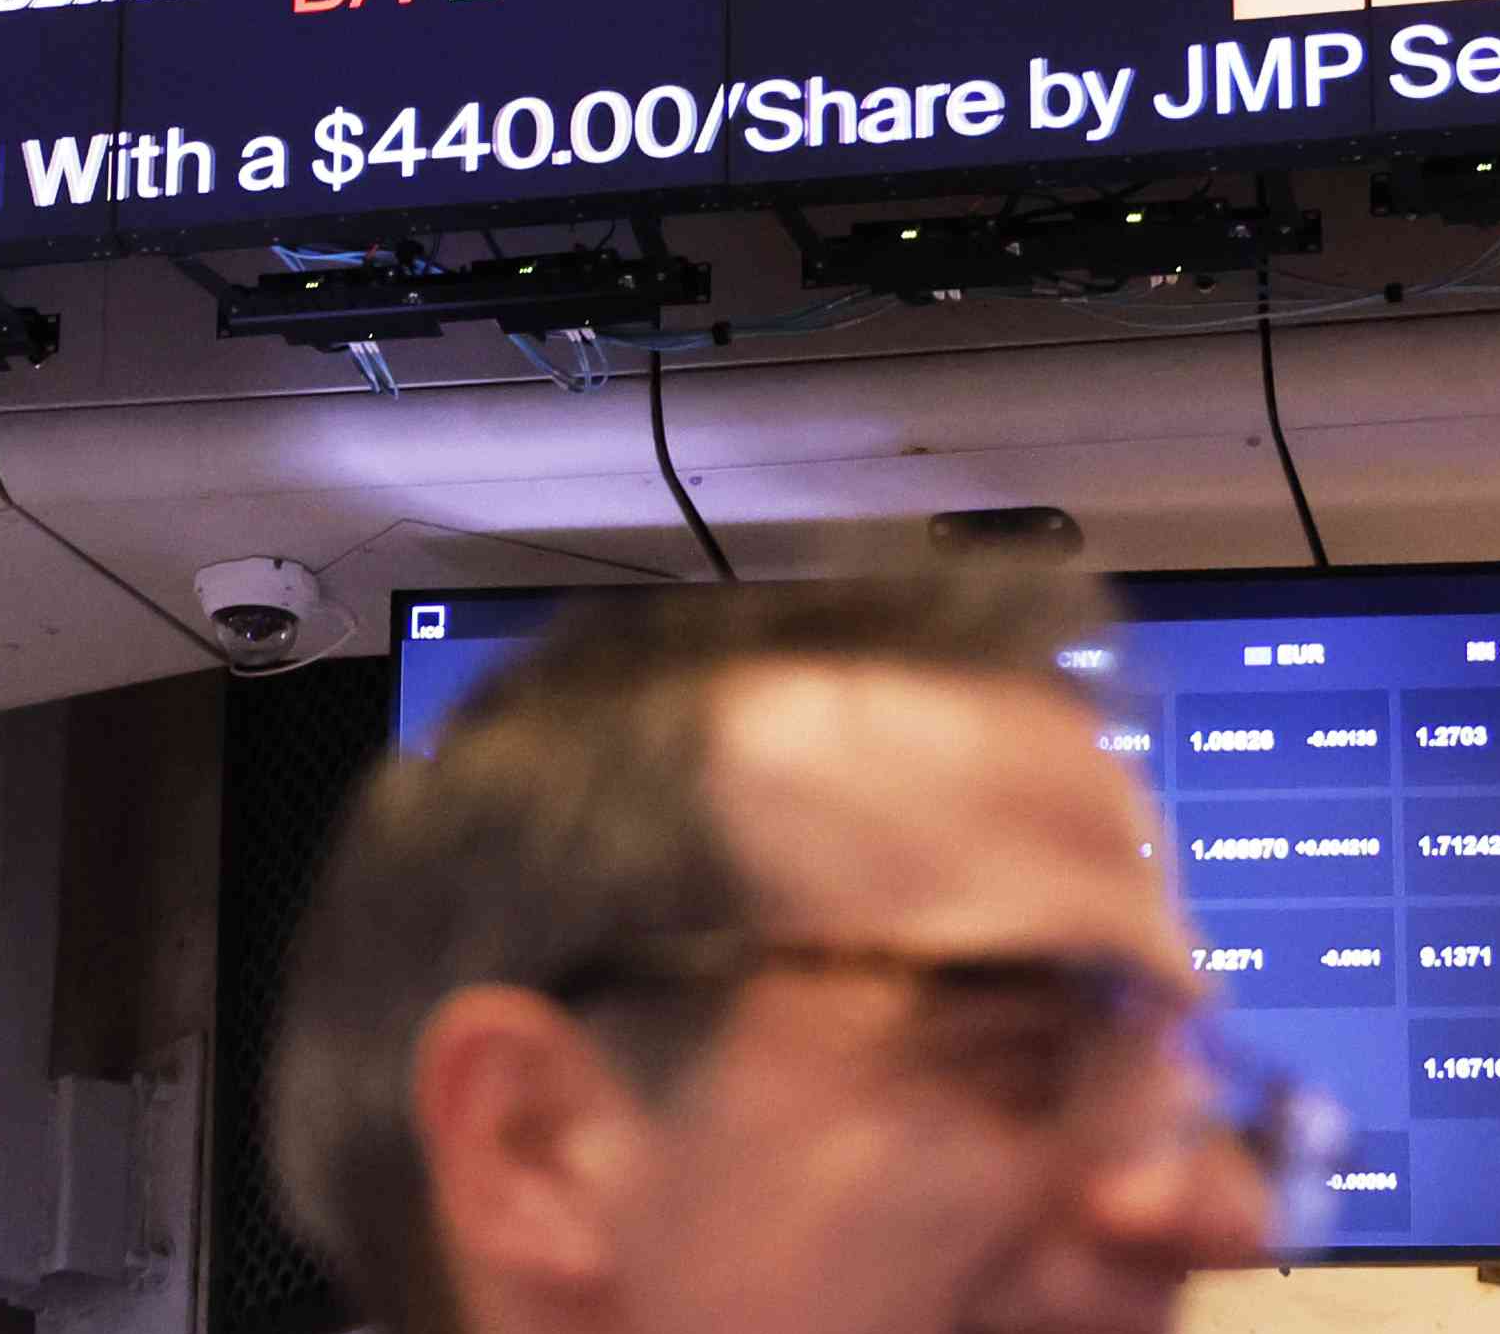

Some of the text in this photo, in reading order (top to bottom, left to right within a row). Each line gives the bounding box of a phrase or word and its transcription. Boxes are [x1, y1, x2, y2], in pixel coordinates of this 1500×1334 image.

[22, 127, 214, 207] With
[238, 136, 285, 191] a
[312, 76, 1005, 191] $440.00/Share
[1030, 58, 1134, 141] by
[1153, 33, 1363, 119] JMP
[1056, 649, 1103, 668] CNY
[1416, 726, 1487, 746] 1.2703
